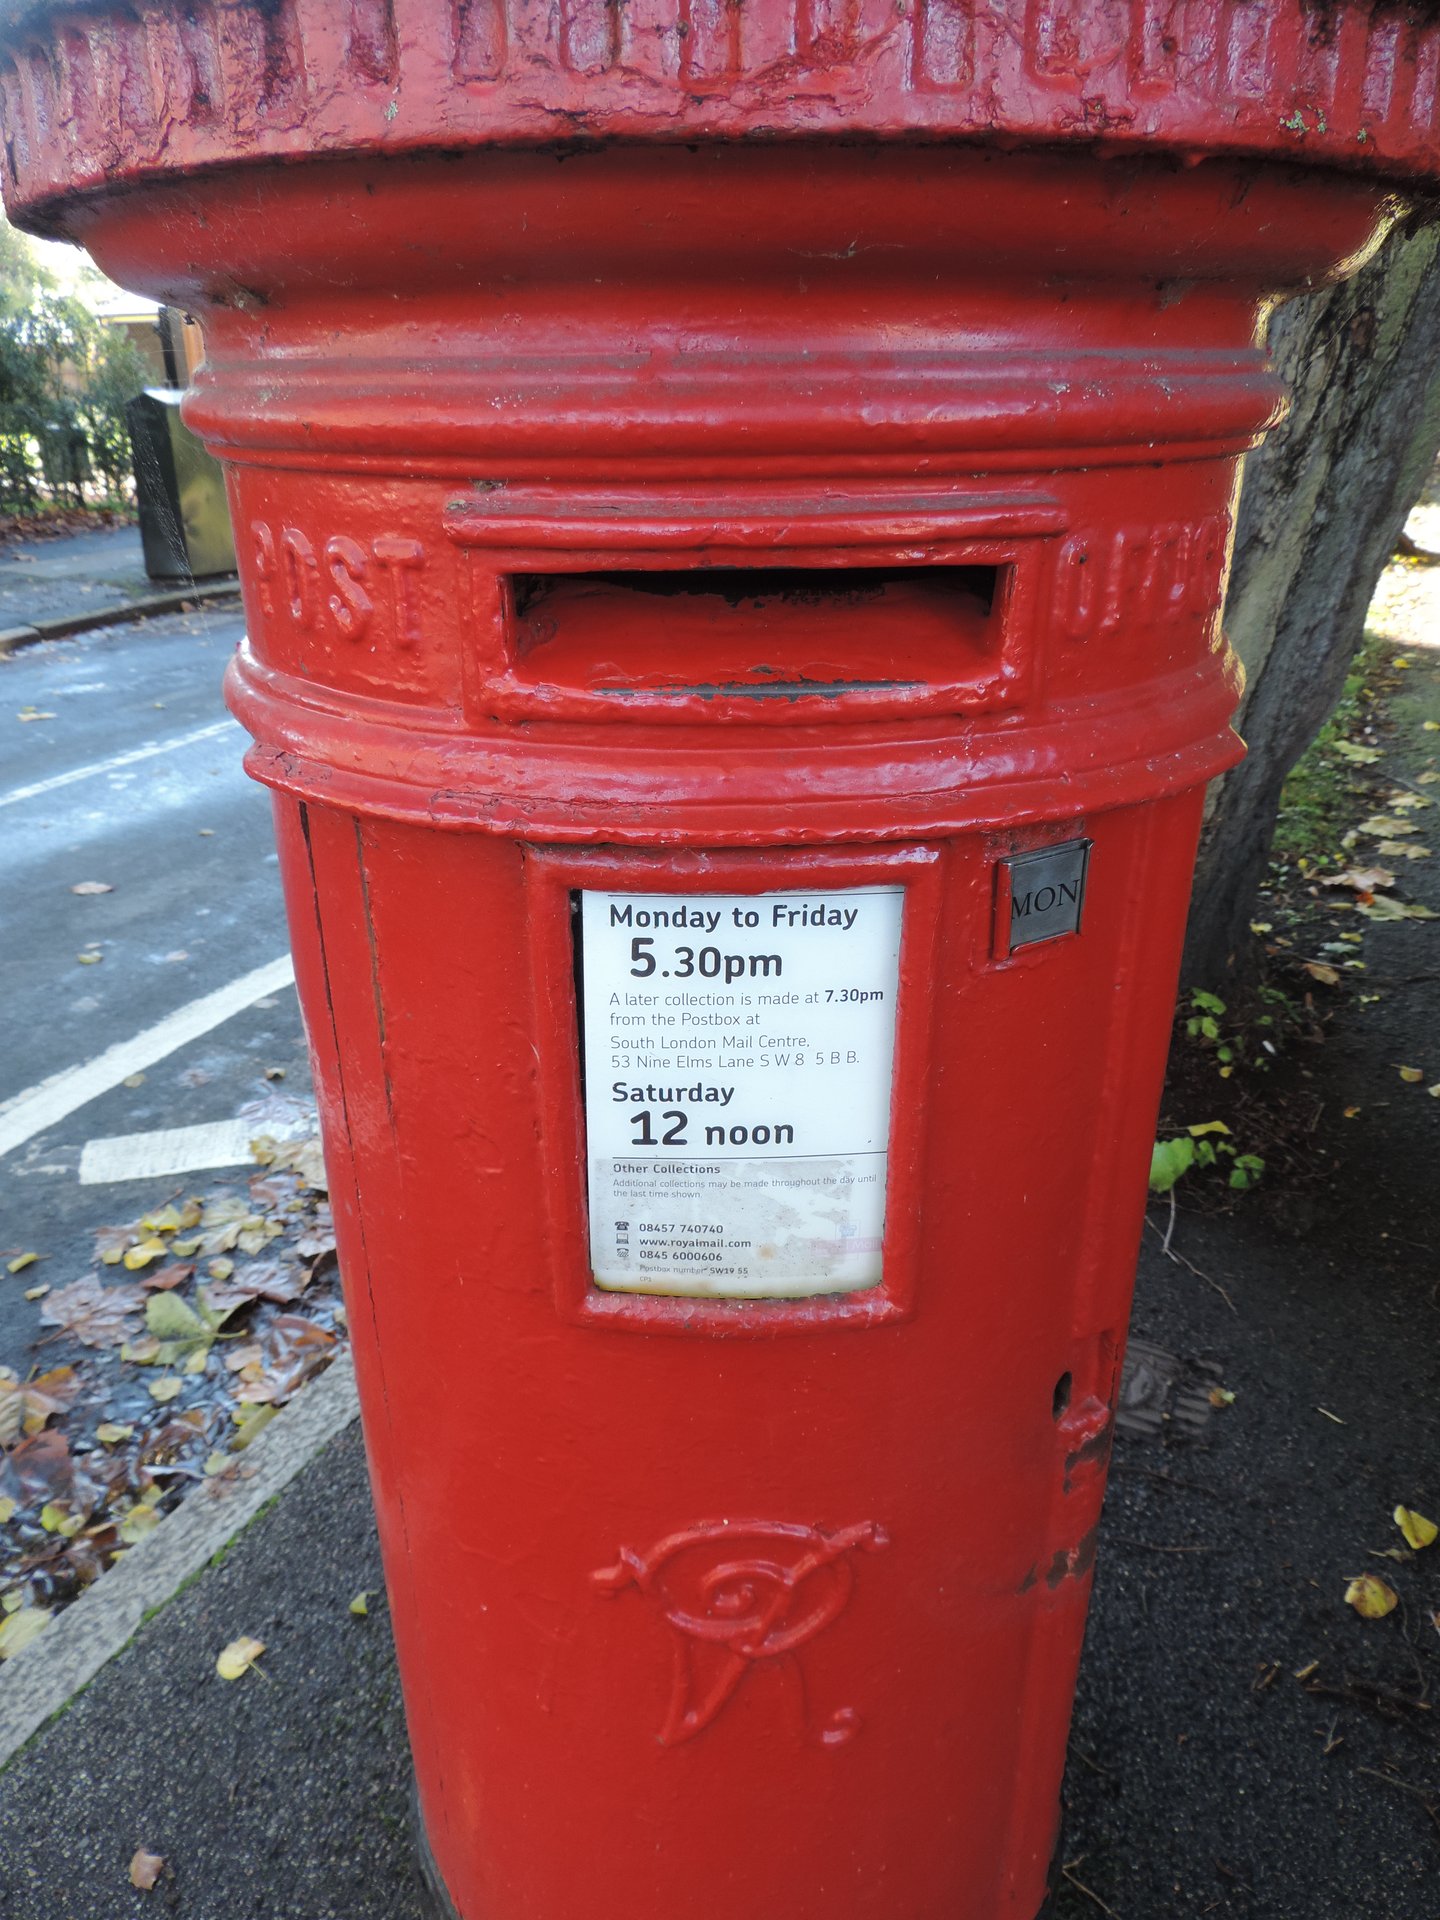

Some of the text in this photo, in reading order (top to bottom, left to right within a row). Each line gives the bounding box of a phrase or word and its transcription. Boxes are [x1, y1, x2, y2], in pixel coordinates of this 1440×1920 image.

[251, 519, 424, 642] POST
[1011, 879, 1080, 920] MON
[610, 903, 858, 933] Monday to Friday
[629, 937, 783, 984] 5.30pm
[609, 988, 884, 1006] A later collection is made at 7.30pm
[610, 1012, 761, 1026] from the Postbox at
[610, 1035, 655, 1049] South
[661, 1035, 716, 1049] London
[722, 1035, 753, 1049] Mail
[611, 1054, 631, 1068] 53
[637, 1054, 671, 1068] Nine
[676, 1054, 713, 1068] Elms
[718, 1054, 755, 1068] Lane
[612, 1081, 735, 1107] Saturday
[630, 1110, 795, 1146] 12 noon
[612, 1163, 721, 1174] Other Collections
[612, 1174, 877, 1190] Additional collections may be made throughout the day until
[613, 1189, 628, 1198] the
[630, 1189, 646, 1198] last
[648, 1189, 669, 1199] time
[639, 1223, 724, 1234] 08457 740740
[639, 1238, 752, 1249] www.royalmail.com
[639, 1250, 723, 1262] 0845 6000606
[639, 1263, 671, 1273] Postbox
